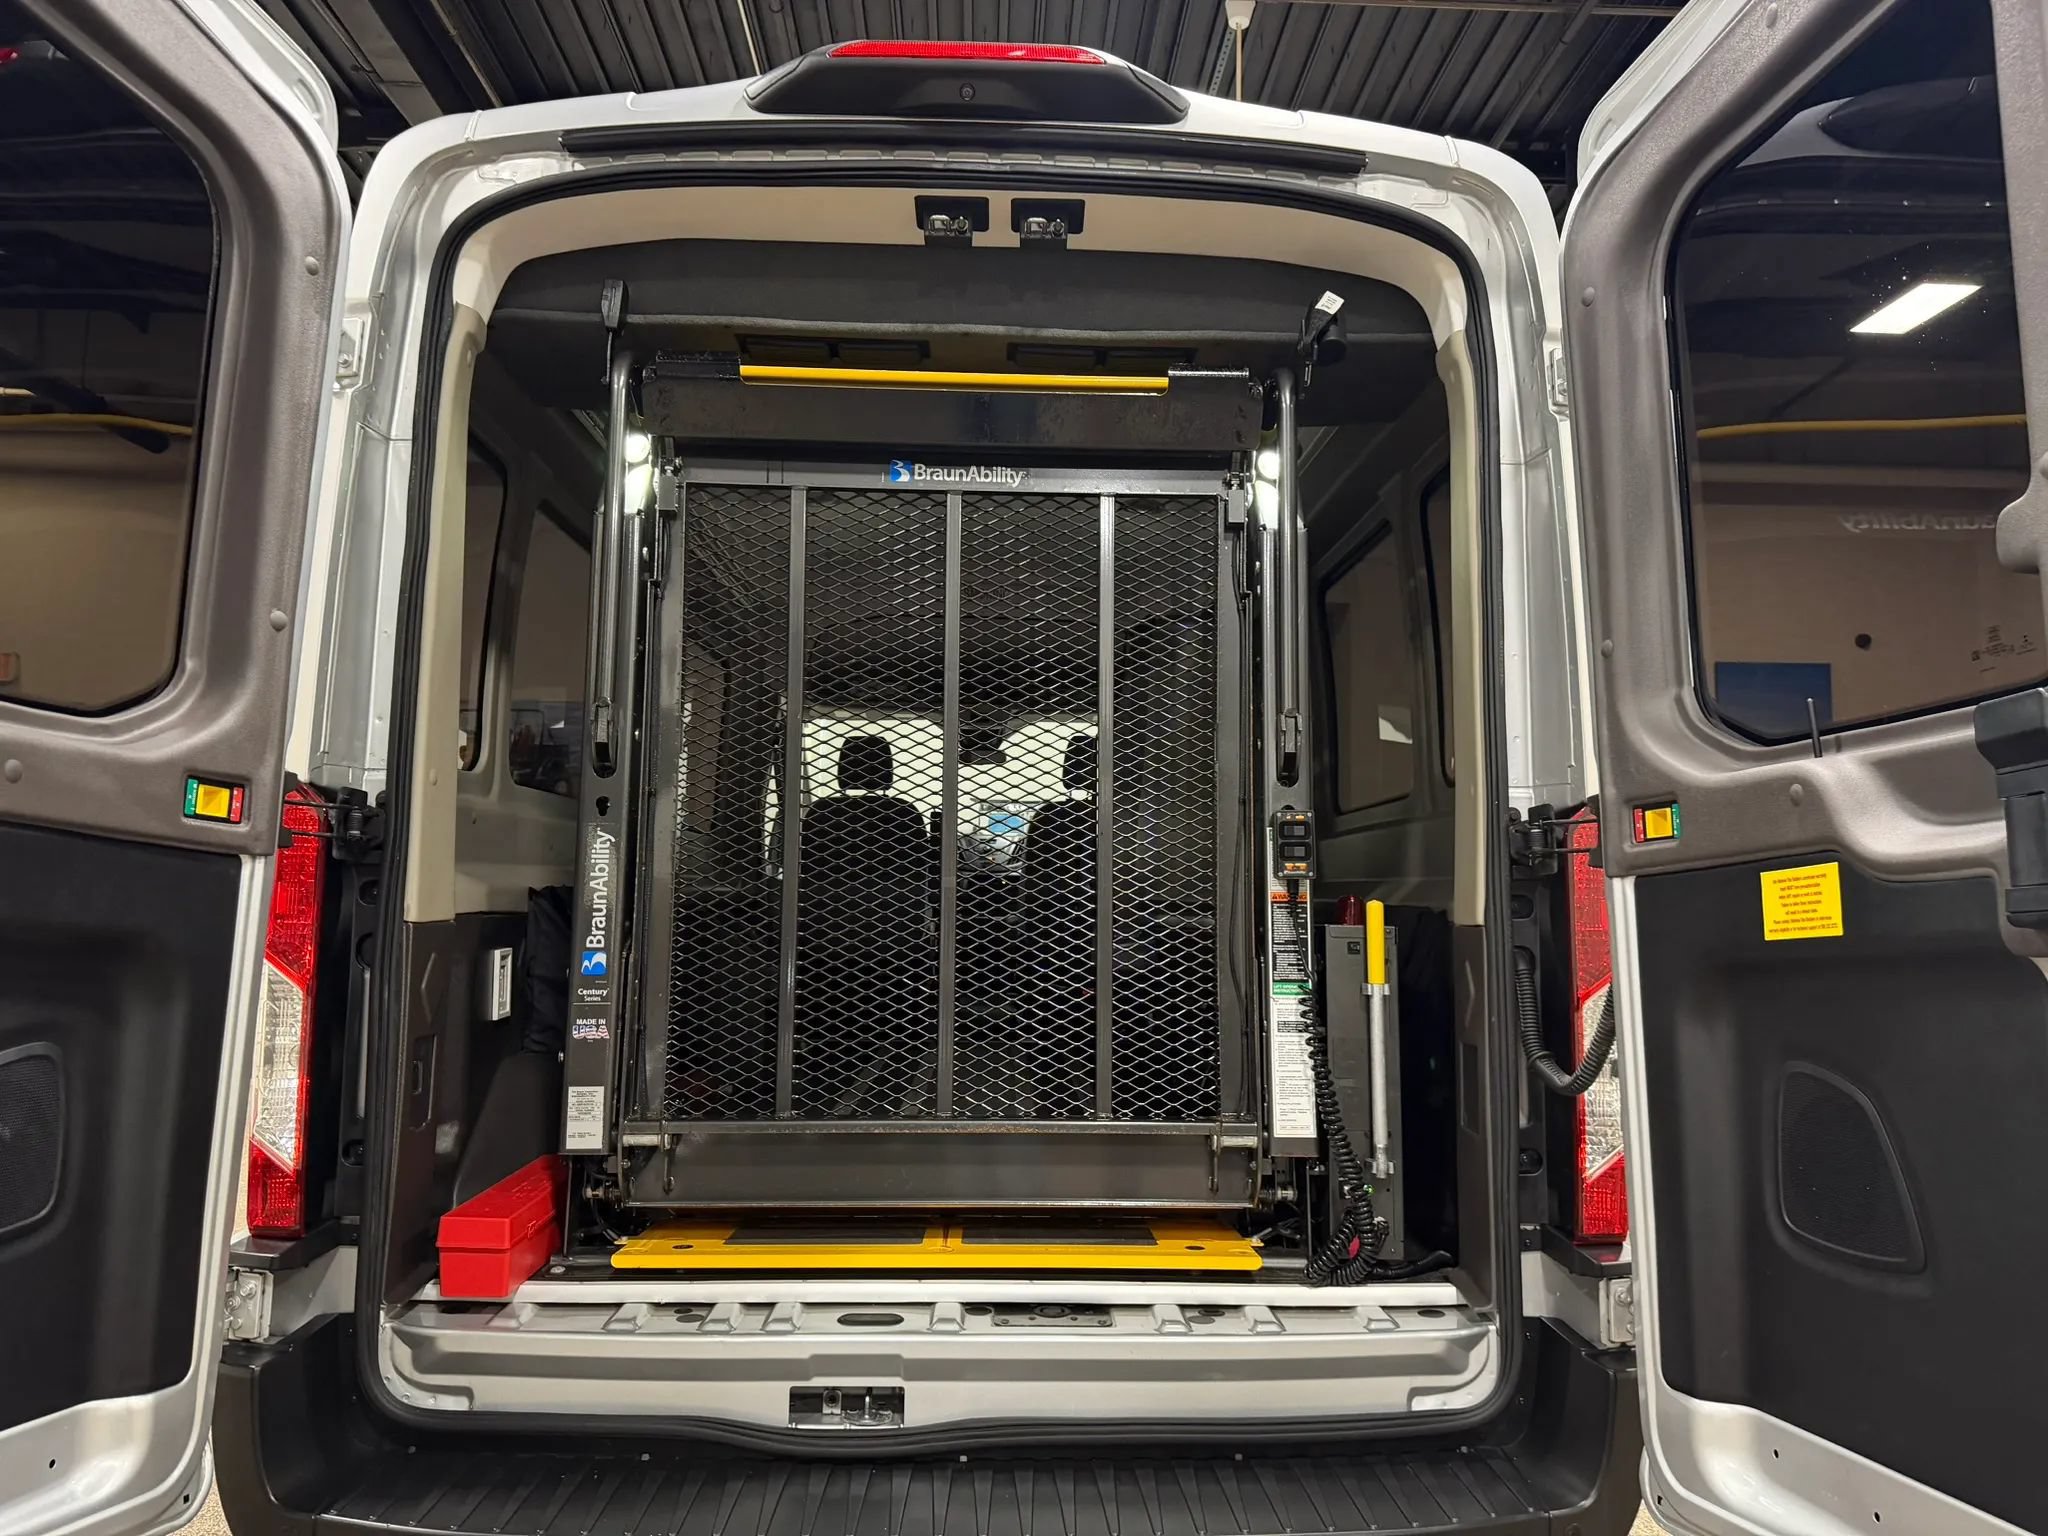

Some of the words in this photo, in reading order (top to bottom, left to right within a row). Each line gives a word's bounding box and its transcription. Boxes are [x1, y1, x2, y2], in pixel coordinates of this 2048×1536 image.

[914, 463, 1023, 488] BraunAbility
[585, 830, 616, 948] BraunAbility
[577, 987, 608, 997] Century
[572, 1025, 610, 1039] USA
